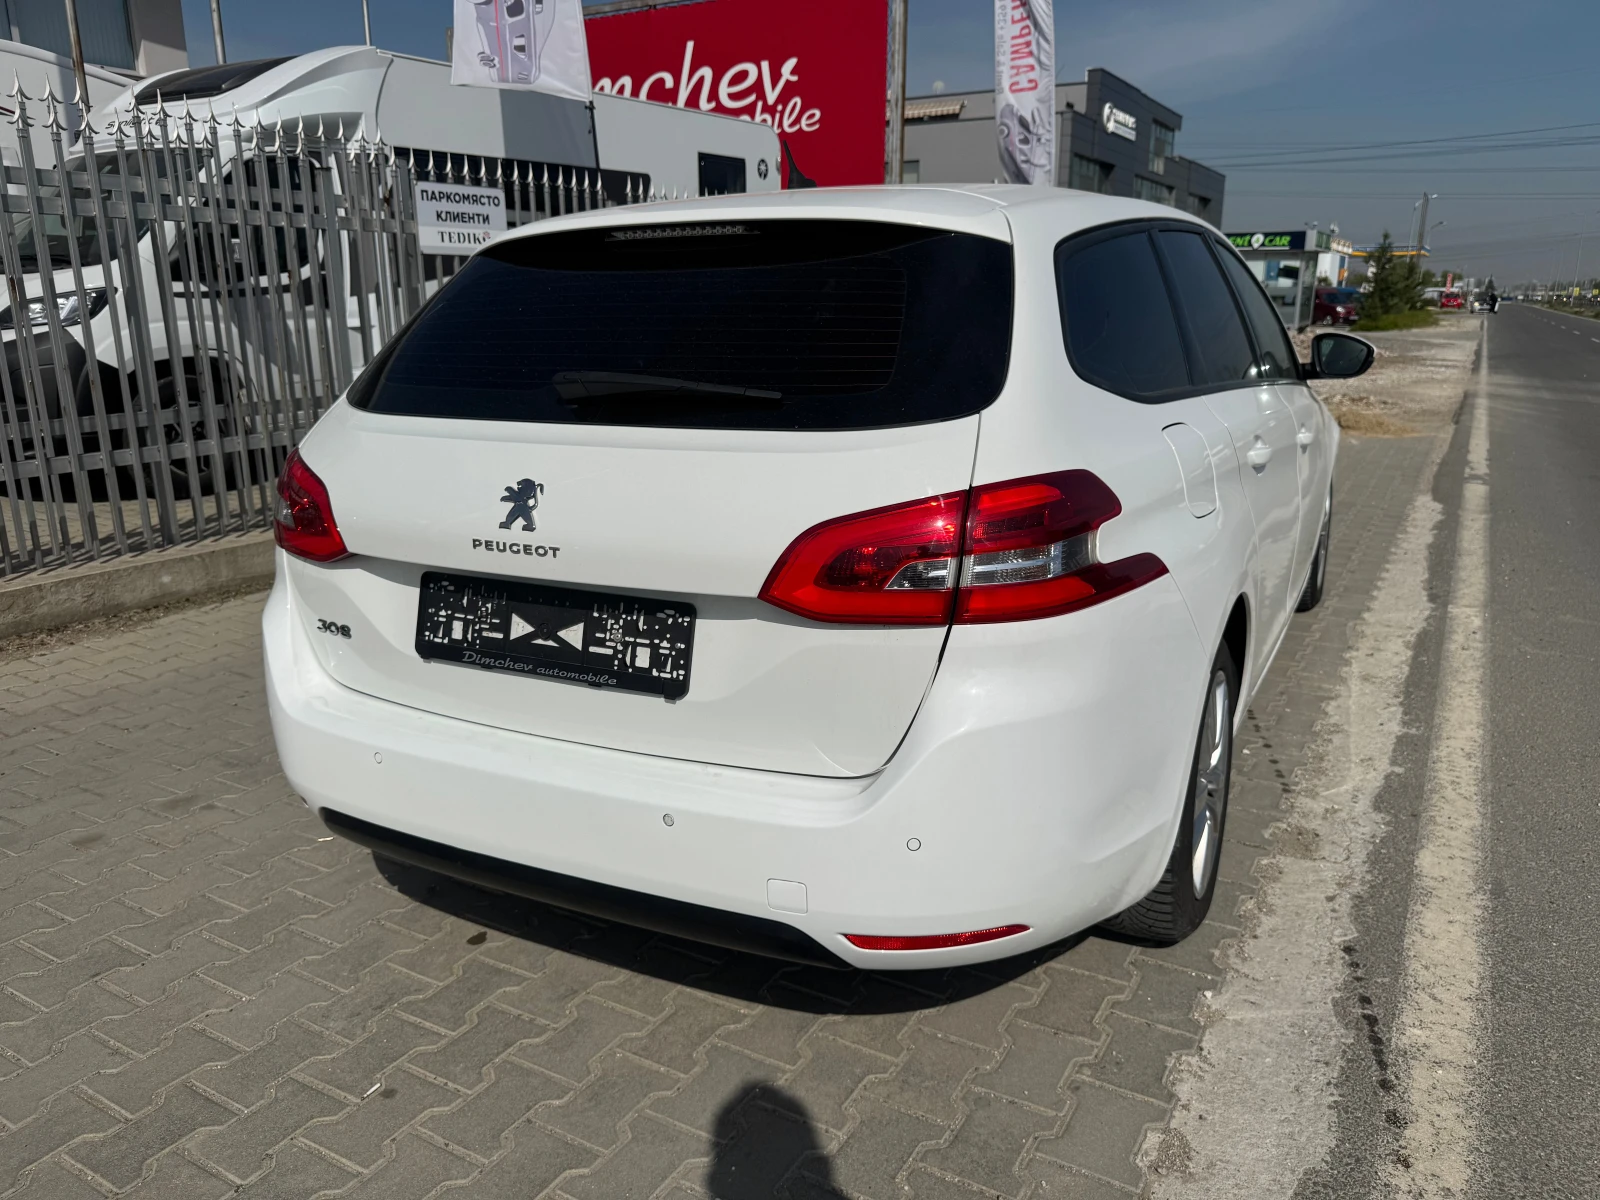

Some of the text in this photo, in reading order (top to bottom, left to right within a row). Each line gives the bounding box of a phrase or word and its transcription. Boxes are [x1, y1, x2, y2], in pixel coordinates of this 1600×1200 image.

[420, 189, 501, 207] ПАРКОМЯСТО
[436, 210, 490, 225] КЛИЕНТИ
[1229, 235, 1251, 247] ENT
[1264, 235, 1292, 247] CAR
[472, 538, 561, 559] PEUGEOT
[316, 618, 353, 640] 308
[461, 650, 618, 686] Dimchev automobile
